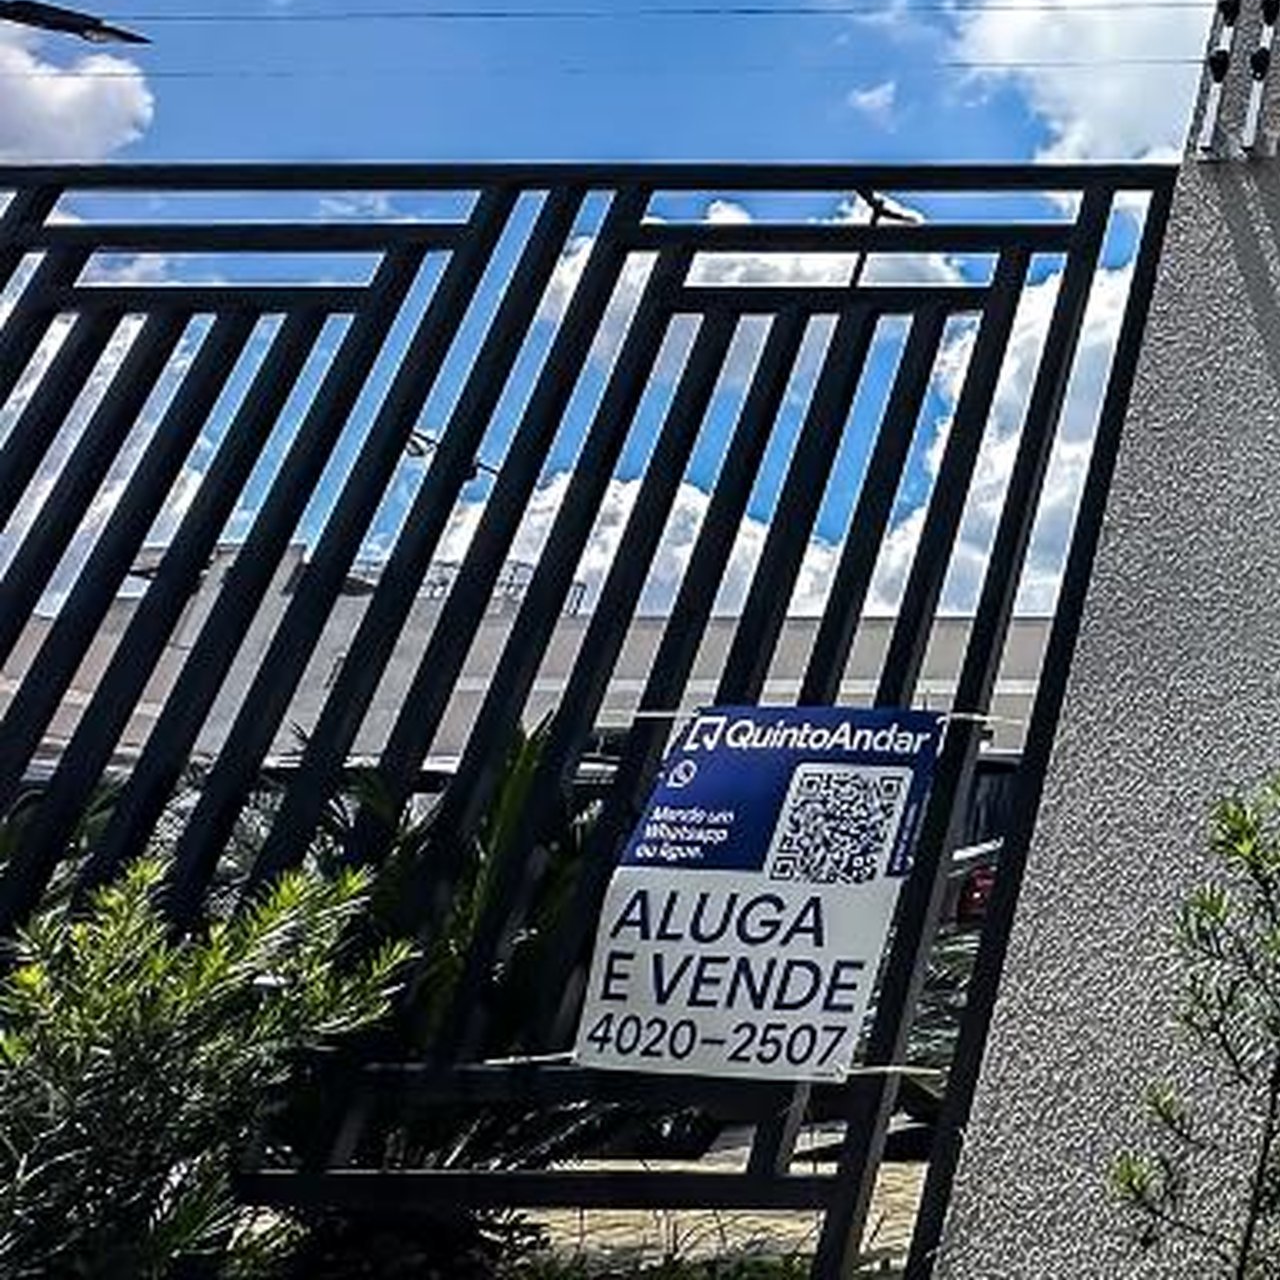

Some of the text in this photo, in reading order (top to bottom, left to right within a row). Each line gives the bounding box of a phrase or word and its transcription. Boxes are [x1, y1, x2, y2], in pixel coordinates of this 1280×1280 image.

[726, 720, 931, 754] QuintoAndar
[610, 891, 825, 947] ALUGA
[601, 951, 864, 1012] E VENDE
[587, 1013, 847, 1066] 4020-2507
